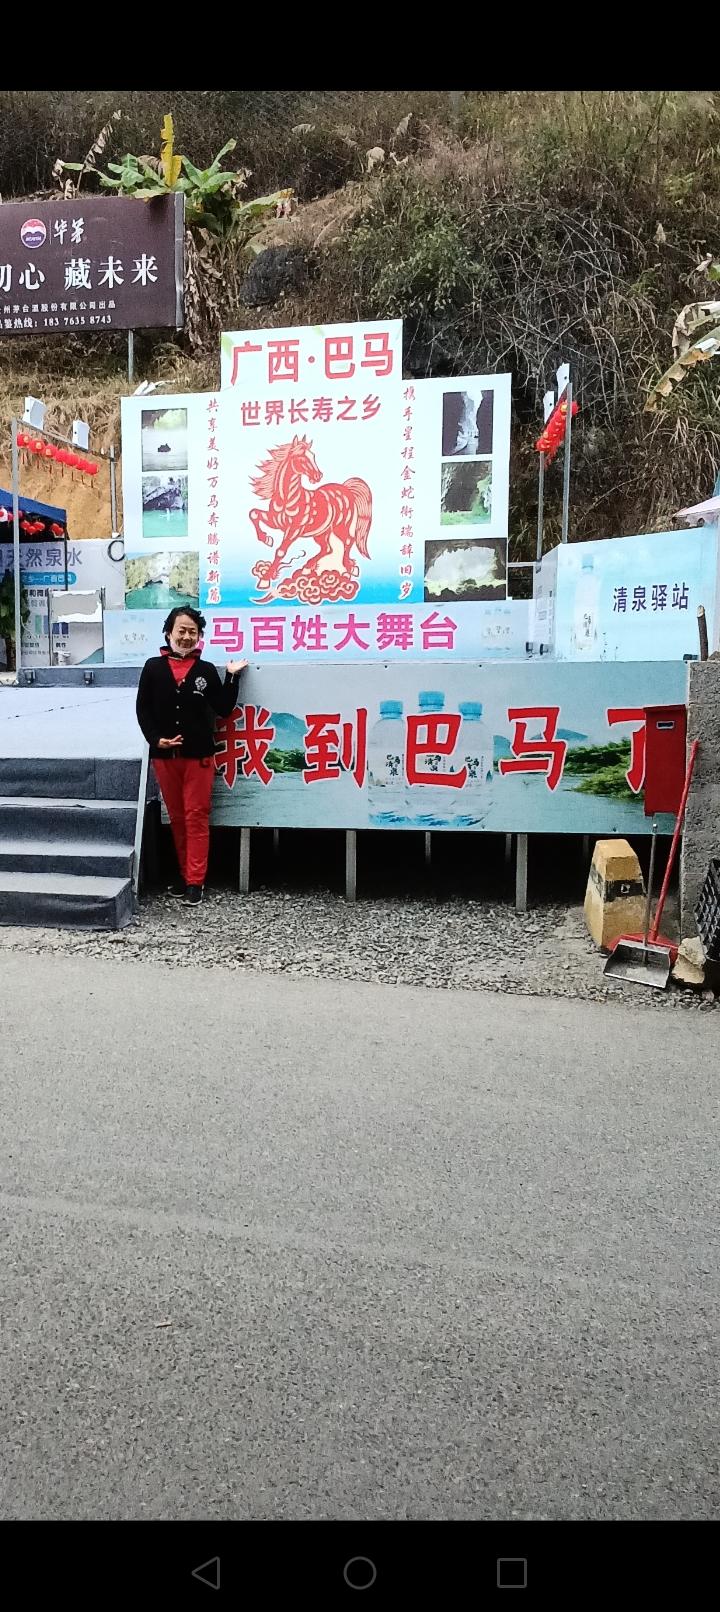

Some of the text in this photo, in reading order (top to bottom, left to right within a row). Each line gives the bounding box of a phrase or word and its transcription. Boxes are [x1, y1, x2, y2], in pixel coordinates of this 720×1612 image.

[64, 253, 159, 291] 藏未来
[0, 300, 116, 314] 州茅台酒股份有限公司出品
[43, 318, 59, 327] 183
[64, 316, 86, 326] 7635
[89, 315, 112, 325] 8743
[230, 332, 394, 385] 广西·巴马
[240, 393, 382, 426] 世界长寿之乡
[612, 582, 690, 613] 清泉驿站
[198, 611, 458, 653] 马百姓大舞台
